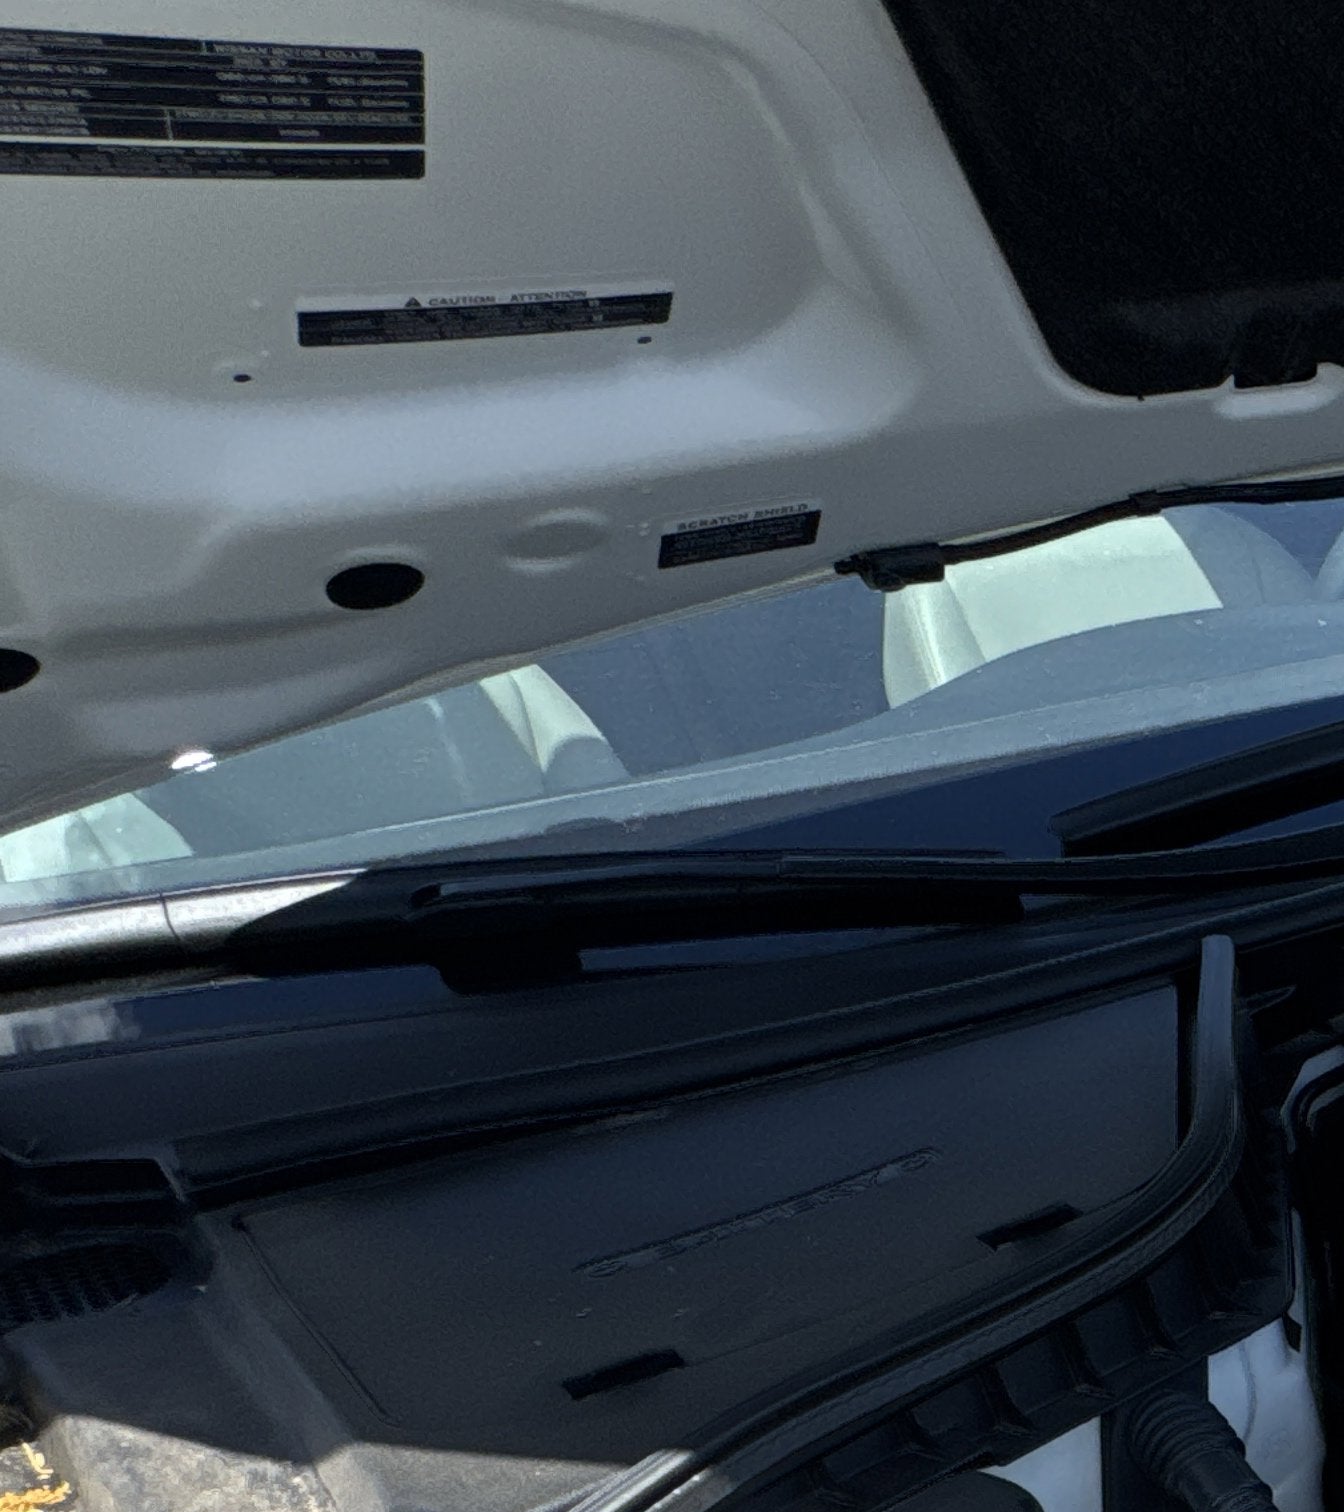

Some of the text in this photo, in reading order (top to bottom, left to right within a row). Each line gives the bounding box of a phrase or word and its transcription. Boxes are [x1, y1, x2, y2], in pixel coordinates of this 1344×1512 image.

[428, 290, 587, 306] CAUTION ATTENTION
[678, 503, 808, 530] SCRATCH SHIELD
